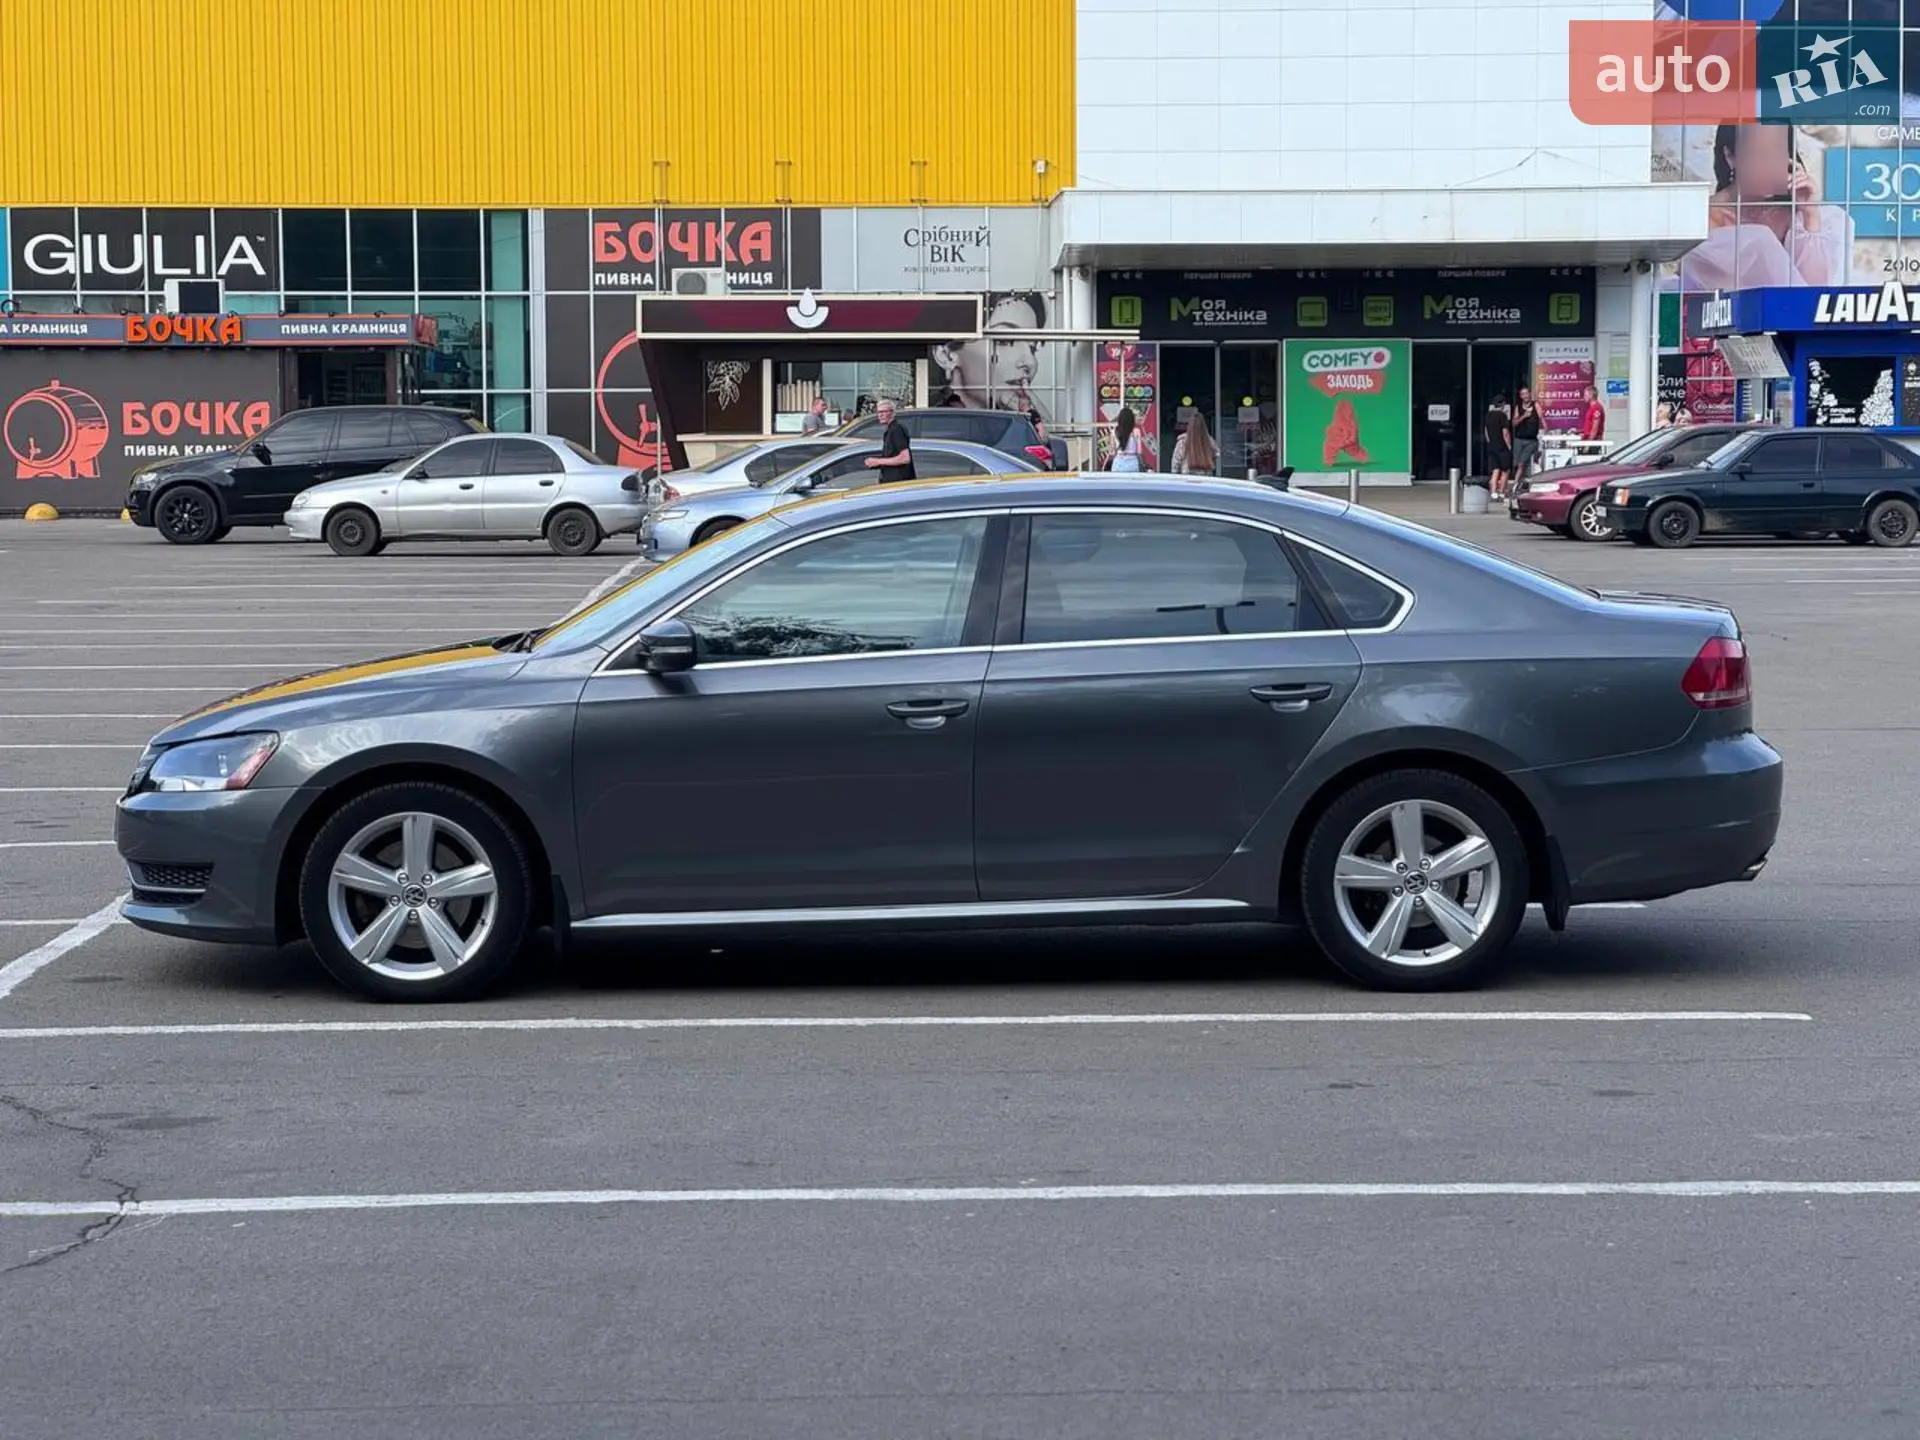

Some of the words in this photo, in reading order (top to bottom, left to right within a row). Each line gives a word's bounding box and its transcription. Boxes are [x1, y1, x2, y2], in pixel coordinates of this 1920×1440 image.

[594, 221, 772, 266] БОЧКА
[903, 224, 990, 246] Срібний
[594, 272, 654, 285] ПИВНА
[12, 323, 89, 335] КРАМНИЦЯ
[126, 315, 242, 345] БОЧКА
[281, 323, 328, 335] ПИВНА
[331, 323, 407, 335] КРАМНИЦЯ
[1307, 351, 1373, 368] COMFY
[1326, 373, 1374, 390] ЗАХОДЬ
[122, 401, 271, 438] БОЧКА
[1544, 407, 1580, 417] ЛІДКУЙ
[124, 444, 179, 457] ПИВНА
